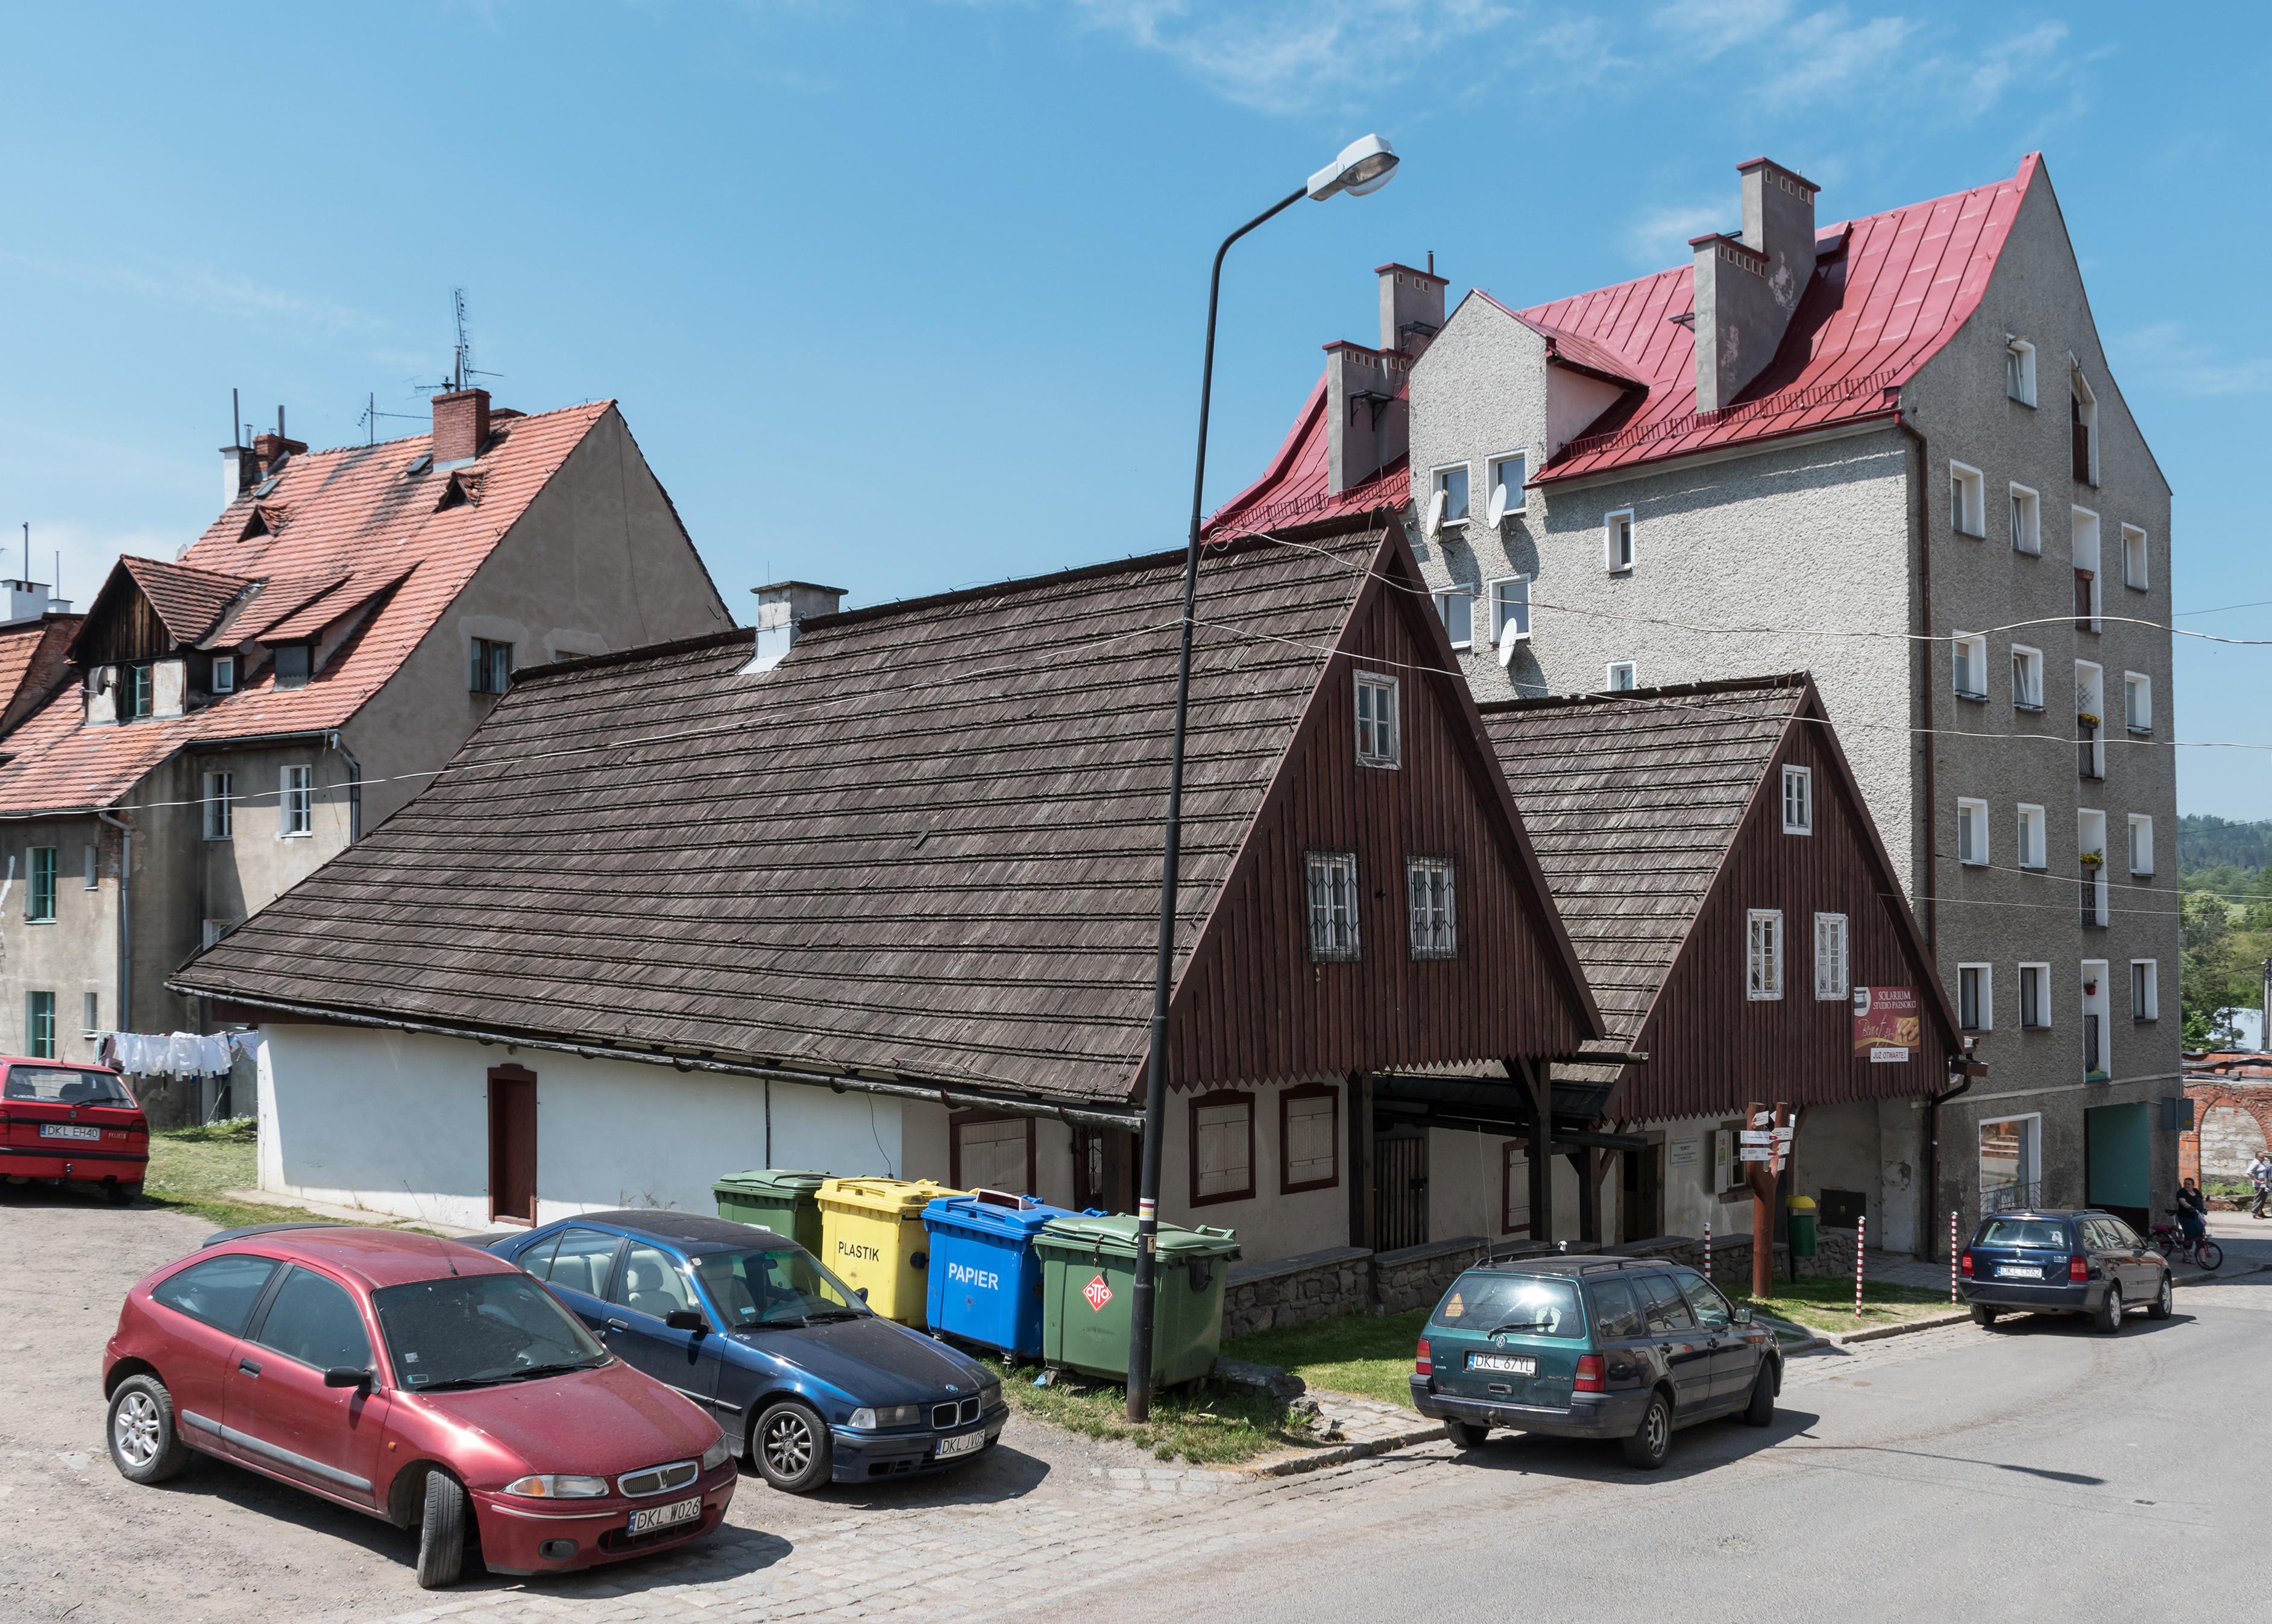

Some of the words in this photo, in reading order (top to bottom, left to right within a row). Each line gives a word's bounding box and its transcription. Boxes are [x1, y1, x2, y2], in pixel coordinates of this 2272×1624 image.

[1878, 990, 1911, 1001] SOLARIUM
[48, 1126, 69, 1136] DKL
[73, 1128, 98, 1138] EH40
[839, 1241, 879, 1262] PLASTIK
[1150, 1238, 1154, 1250] 1
[949, 1262, 998, 1290] PAPIER
[2002, 1267, 2018, 1276] DKL
[2021, 1267, 2041, 1276] CR62
[1086, 1283, 1109, 1304] OTTO
[1476, 1353, 1499, 1368] DKL
[1504, 1356, 1532, 1372] 67YL
[942, 1437, 961, 1453] DKL
[965, 1430, 984, 1449] JV05
[637, 1509, 663, 1530] DKL
[670, 1499, 699, 1522] W026
